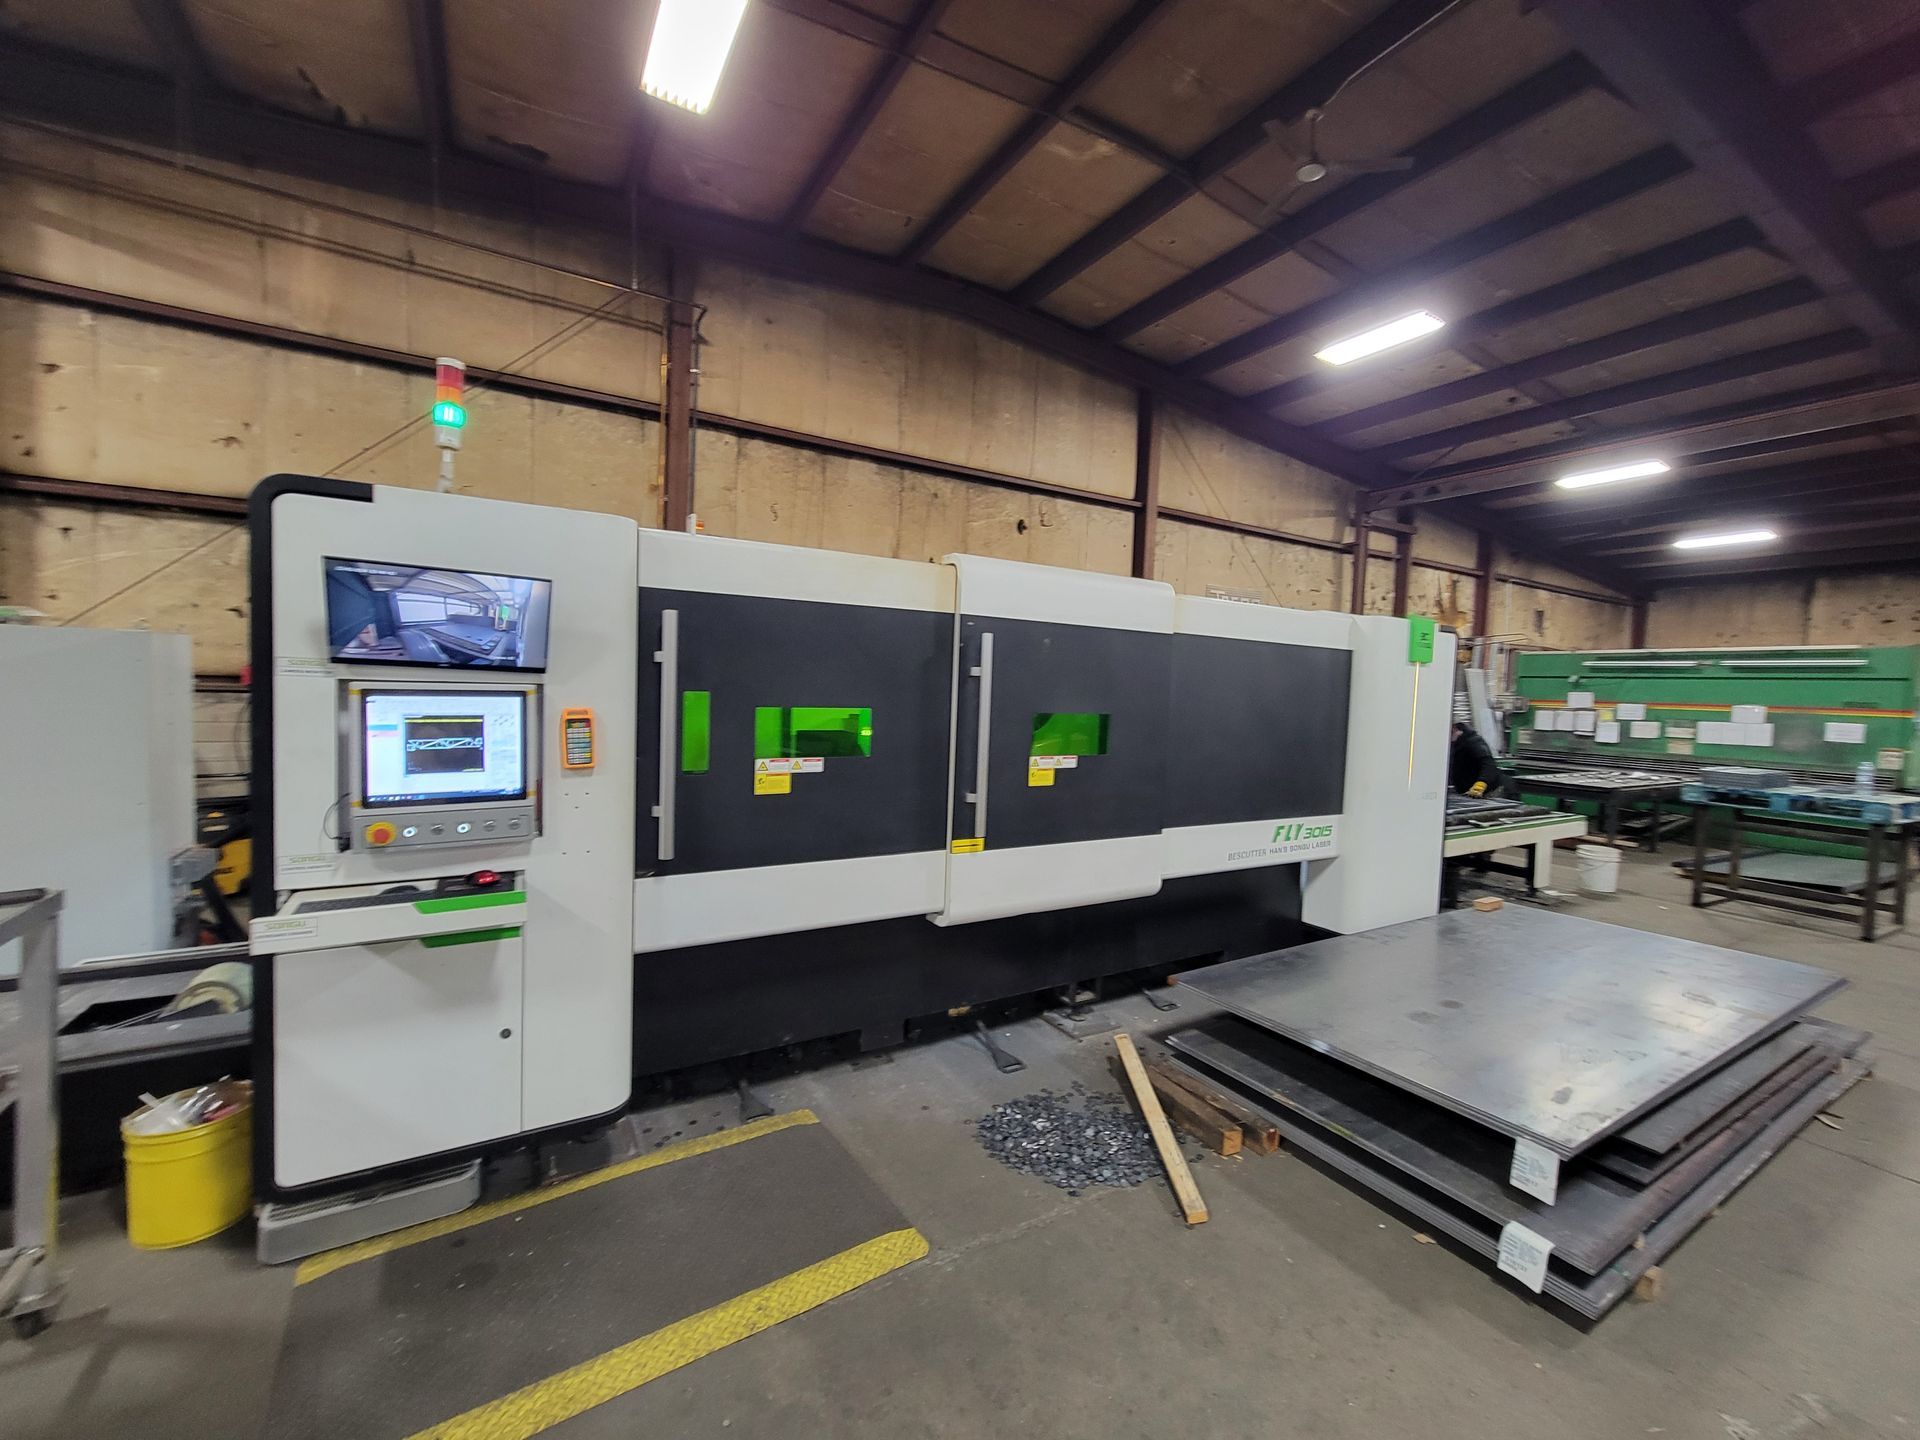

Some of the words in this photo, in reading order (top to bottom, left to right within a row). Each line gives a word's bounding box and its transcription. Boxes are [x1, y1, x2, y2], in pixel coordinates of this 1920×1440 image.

[1272, 823, 1304, 843] FLY
[1303, 825, 1333, 839] 3015
[1228, 849, 1267, 861] BESCUTTER
[1311, 840, 1331, 849] LASER
